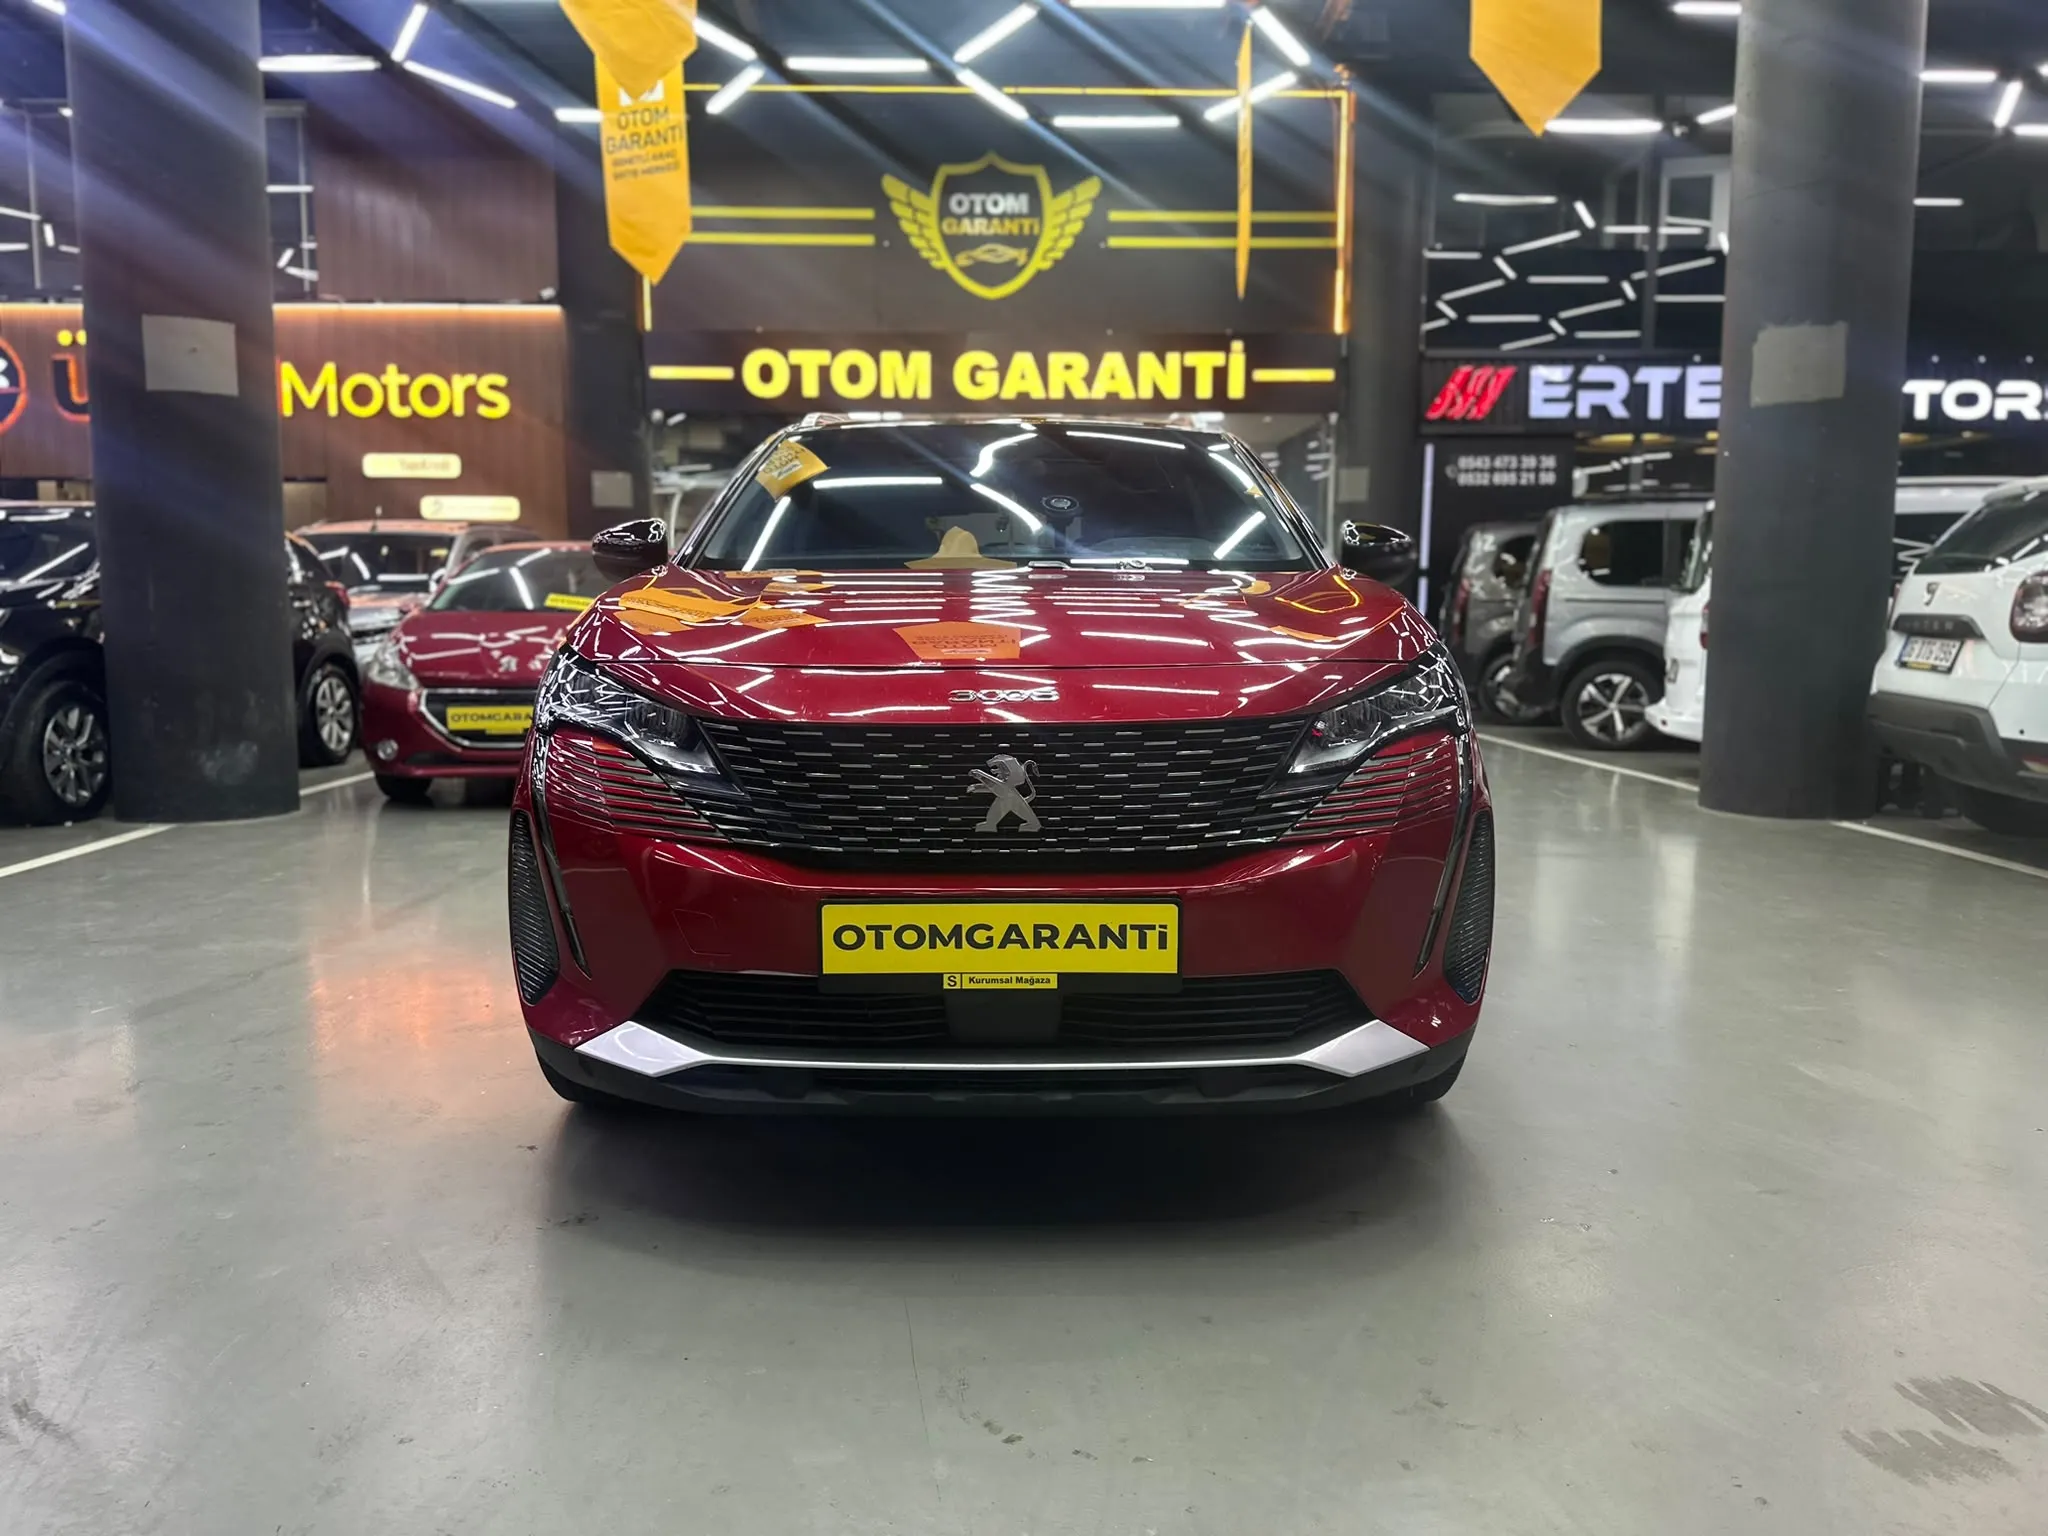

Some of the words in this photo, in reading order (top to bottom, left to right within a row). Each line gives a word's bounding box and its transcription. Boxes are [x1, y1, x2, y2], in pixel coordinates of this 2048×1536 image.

[617, 105, 669, 131] OTOM
[949, 193, 1029, 214] OTOM
[742, 348, 932, 399] OTOM
[952, 340, 1246, 399] GARANTİ
[280, 361, 511, 419] Motors
[947, 975, 957, 987] S
[968, 975, 1013, 985] Kurumsal
[1015, 975, 1051, 986] Mağaza
